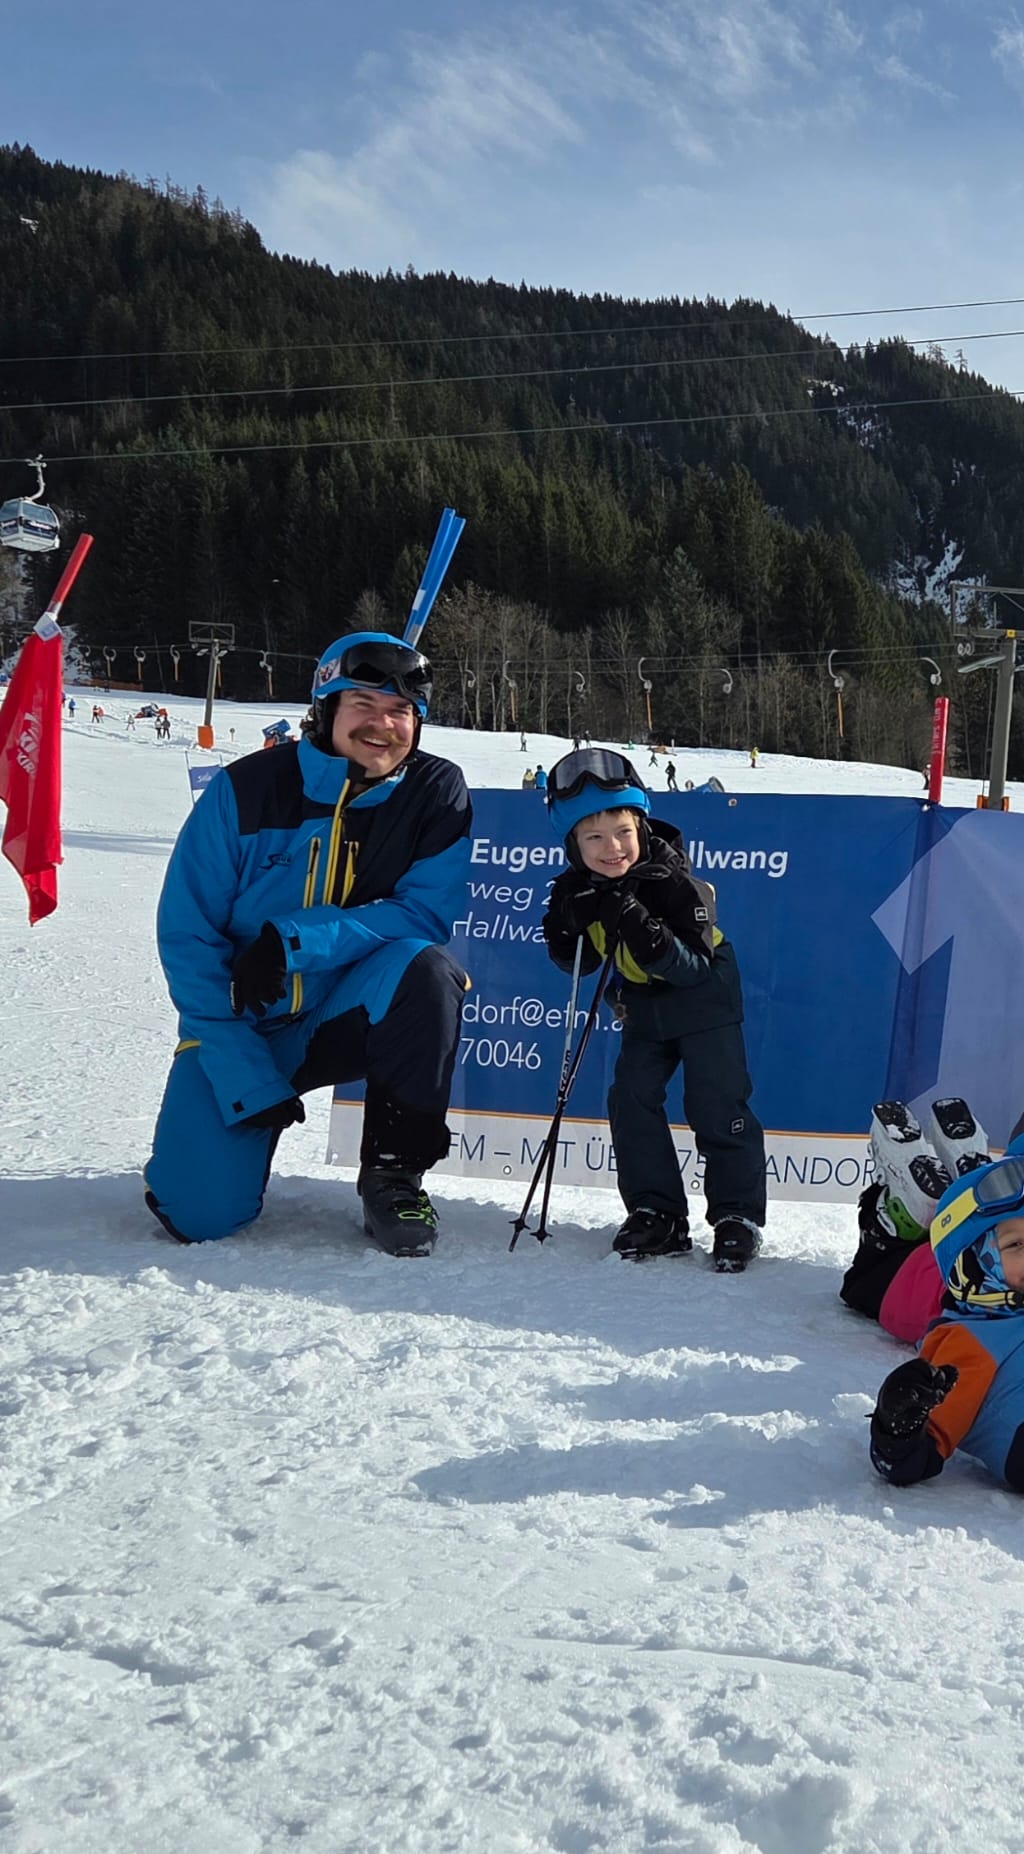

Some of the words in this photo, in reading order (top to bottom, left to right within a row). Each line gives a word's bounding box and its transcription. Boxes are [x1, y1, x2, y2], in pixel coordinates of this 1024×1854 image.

[470, 838, 570, 873] Eugen
[689, 840, 788, 878] llwang
[466, 882, 533, 911] weg
[452, 911, 549, 943] Hallwa
[461, 994, 624, 1032] dorf@efm.a
[447, 1131, 486, 1162] FM
[520, 1137, 577, 1168] MT
[764, 1154, 877, 1187] ANDOR
